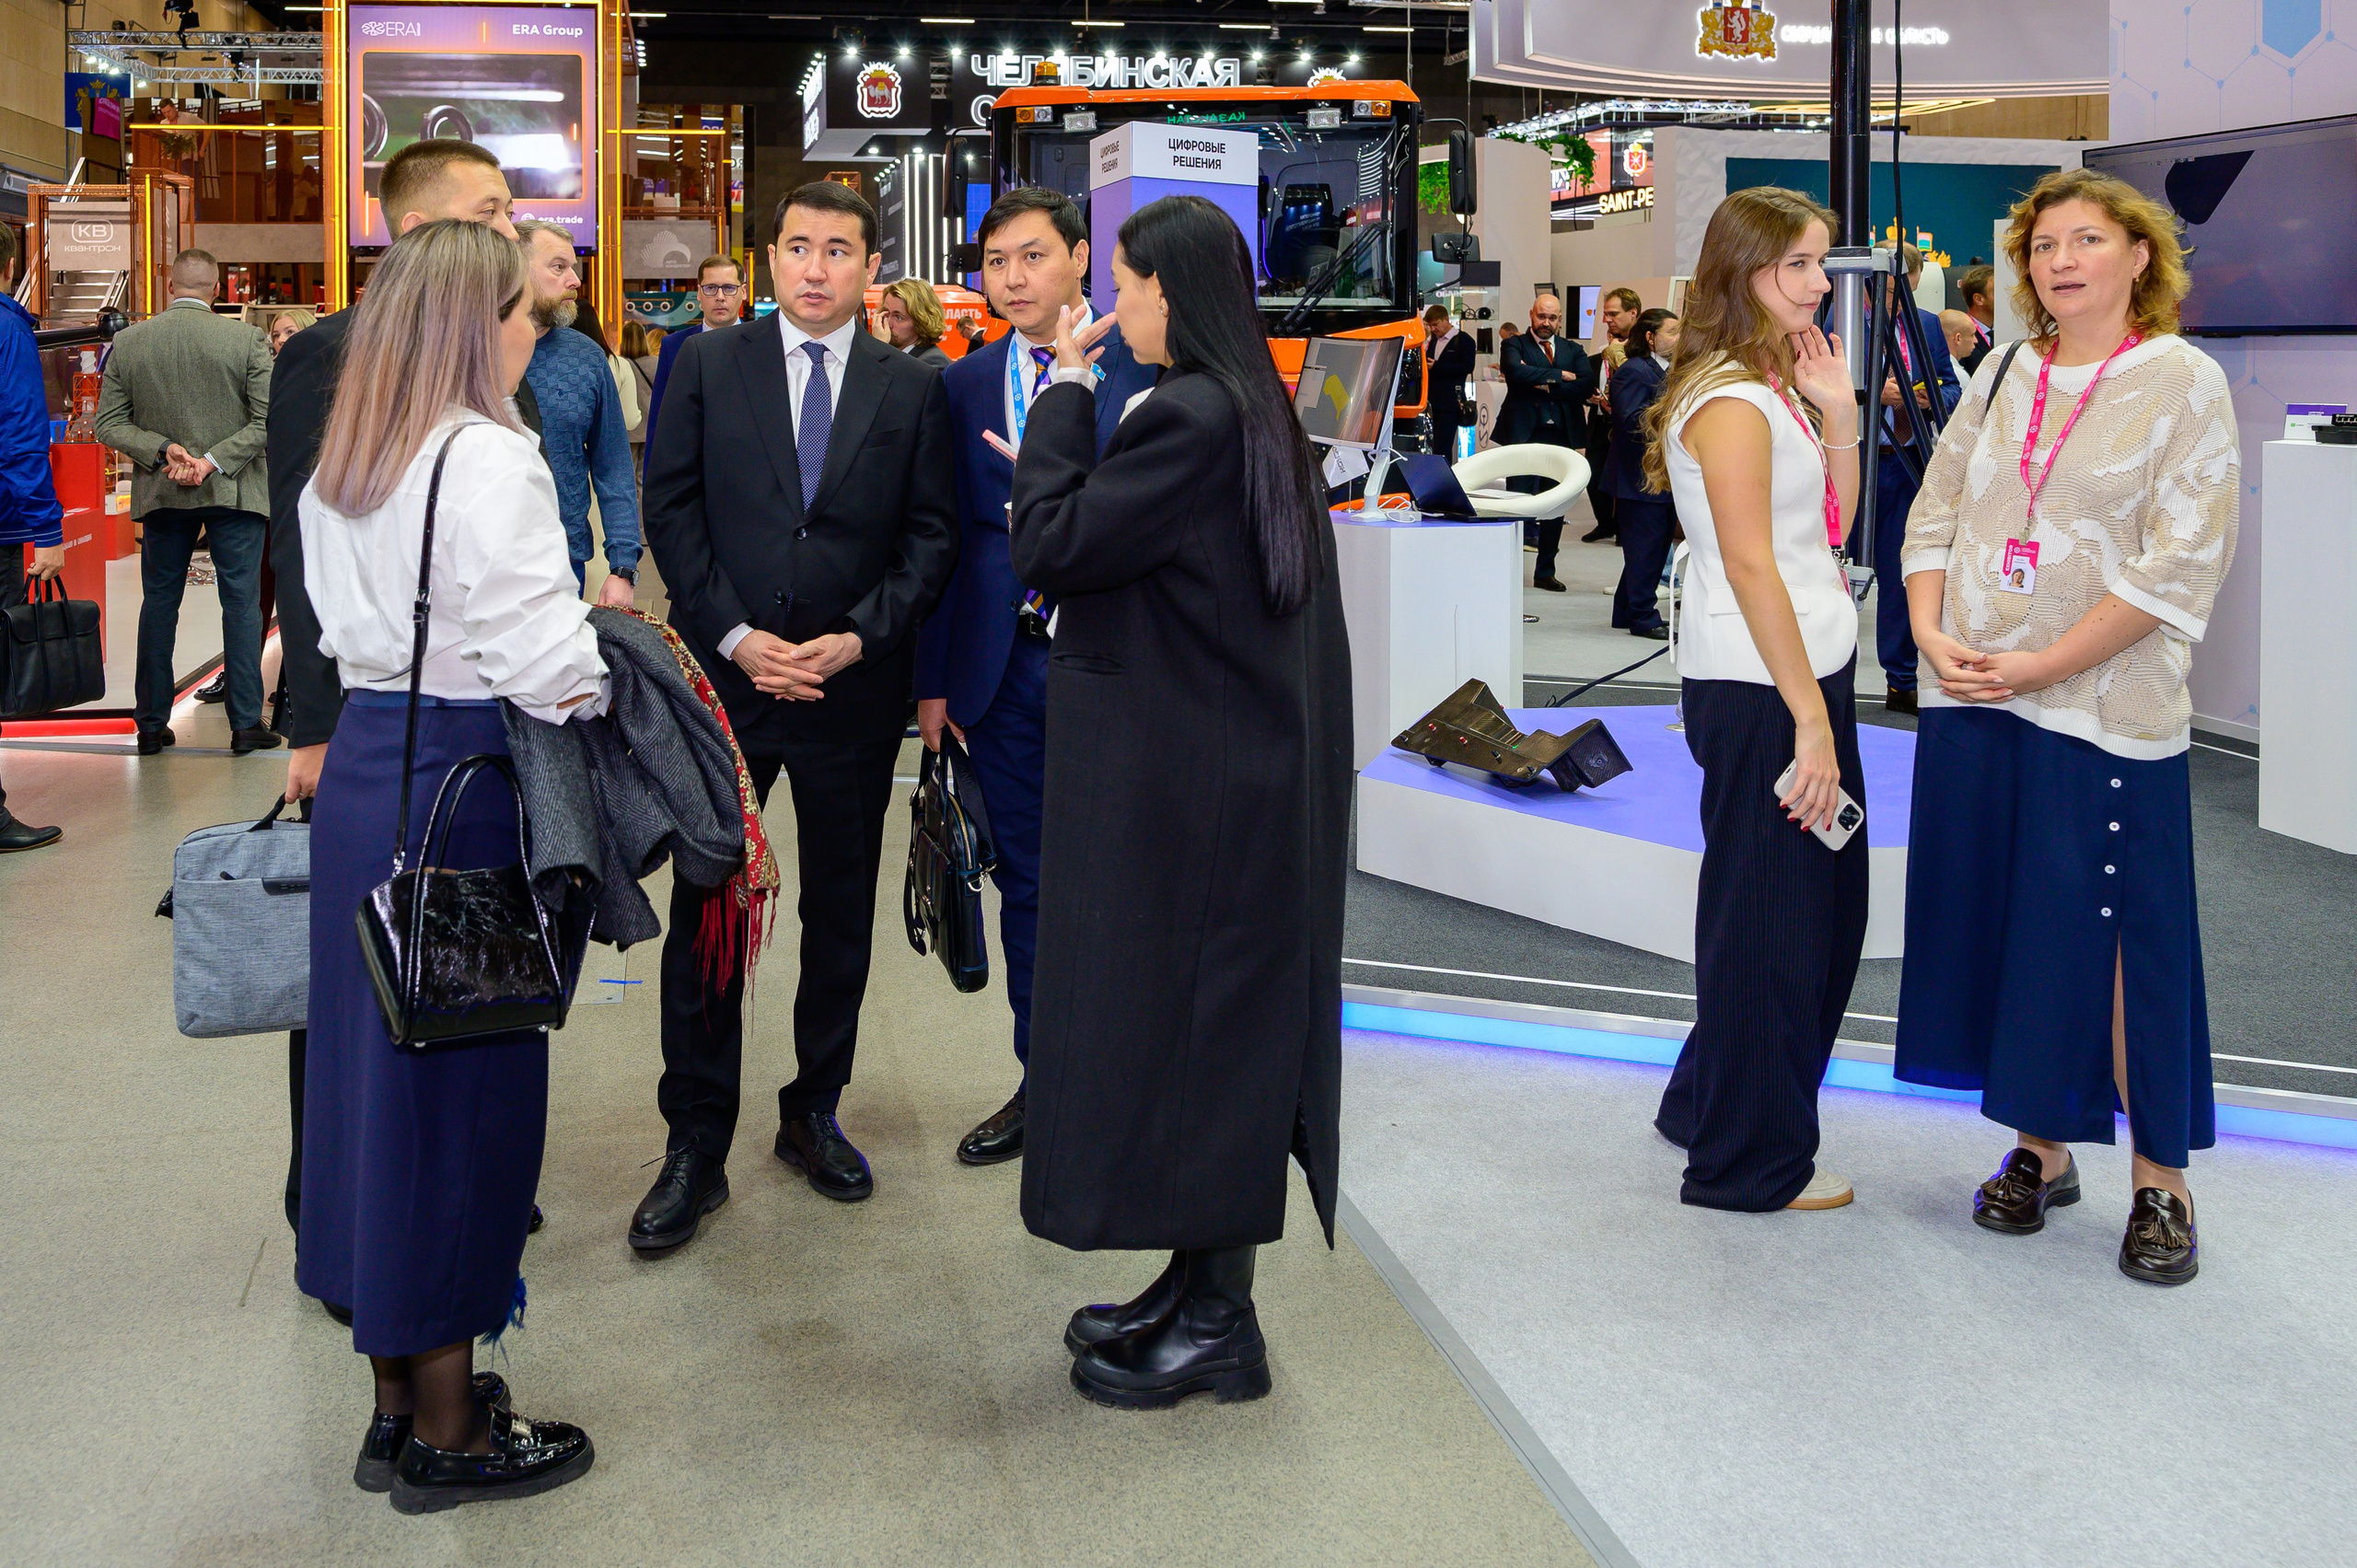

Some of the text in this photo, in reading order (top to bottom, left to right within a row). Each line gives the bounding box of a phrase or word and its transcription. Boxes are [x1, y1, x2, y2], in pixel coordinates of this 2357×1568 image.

[512, 24, 584, 39] ERA Group
[1168, 138, 1226, 154] ЦИФРОВЫЕ
[1173, 156, 1222, 169] РЕШЕНИЯ
